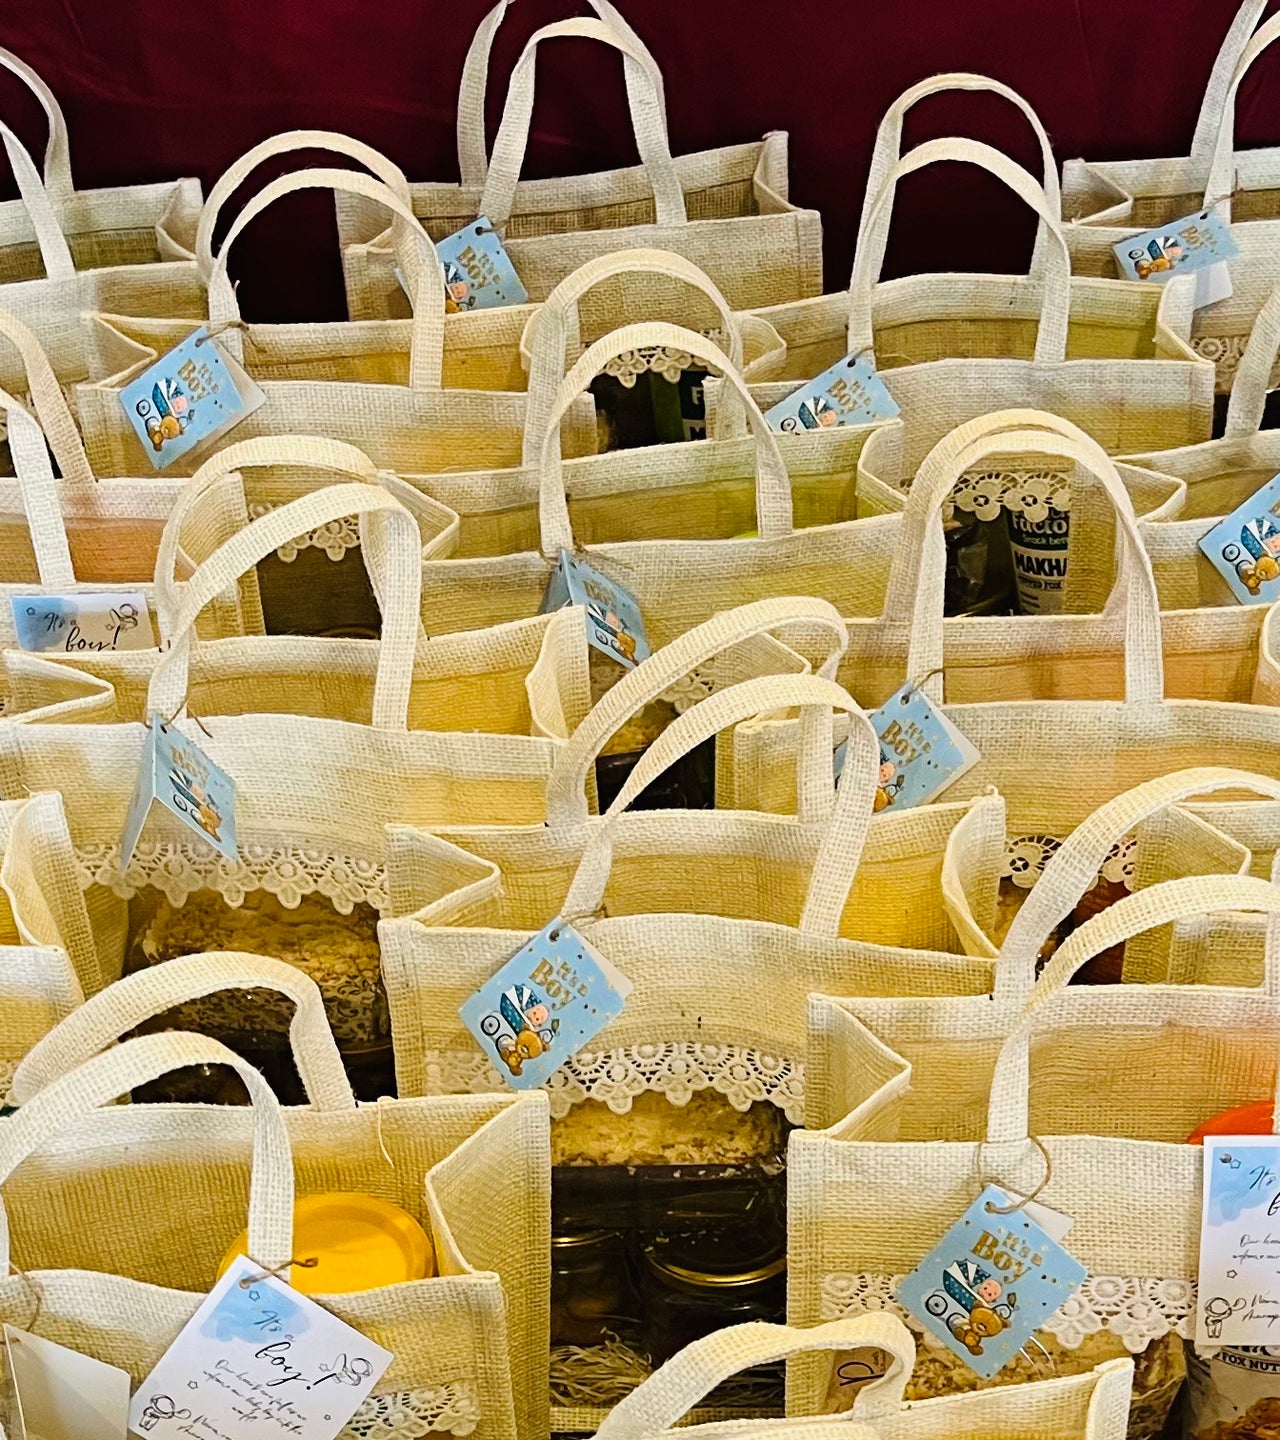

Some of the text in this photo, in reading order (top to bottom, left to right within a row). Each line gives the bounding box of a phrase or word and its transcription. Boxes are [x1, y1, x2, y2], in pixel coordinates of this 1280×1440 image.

[1012, 513, 1069, 536] Facto
[1015, 553, 1069, 577] MAKH
[968, 1230, 1030, 1289] Boy
[254, 1341, 328, 1390] boy!
[1222, 1352, 1246, 1368] FOX
